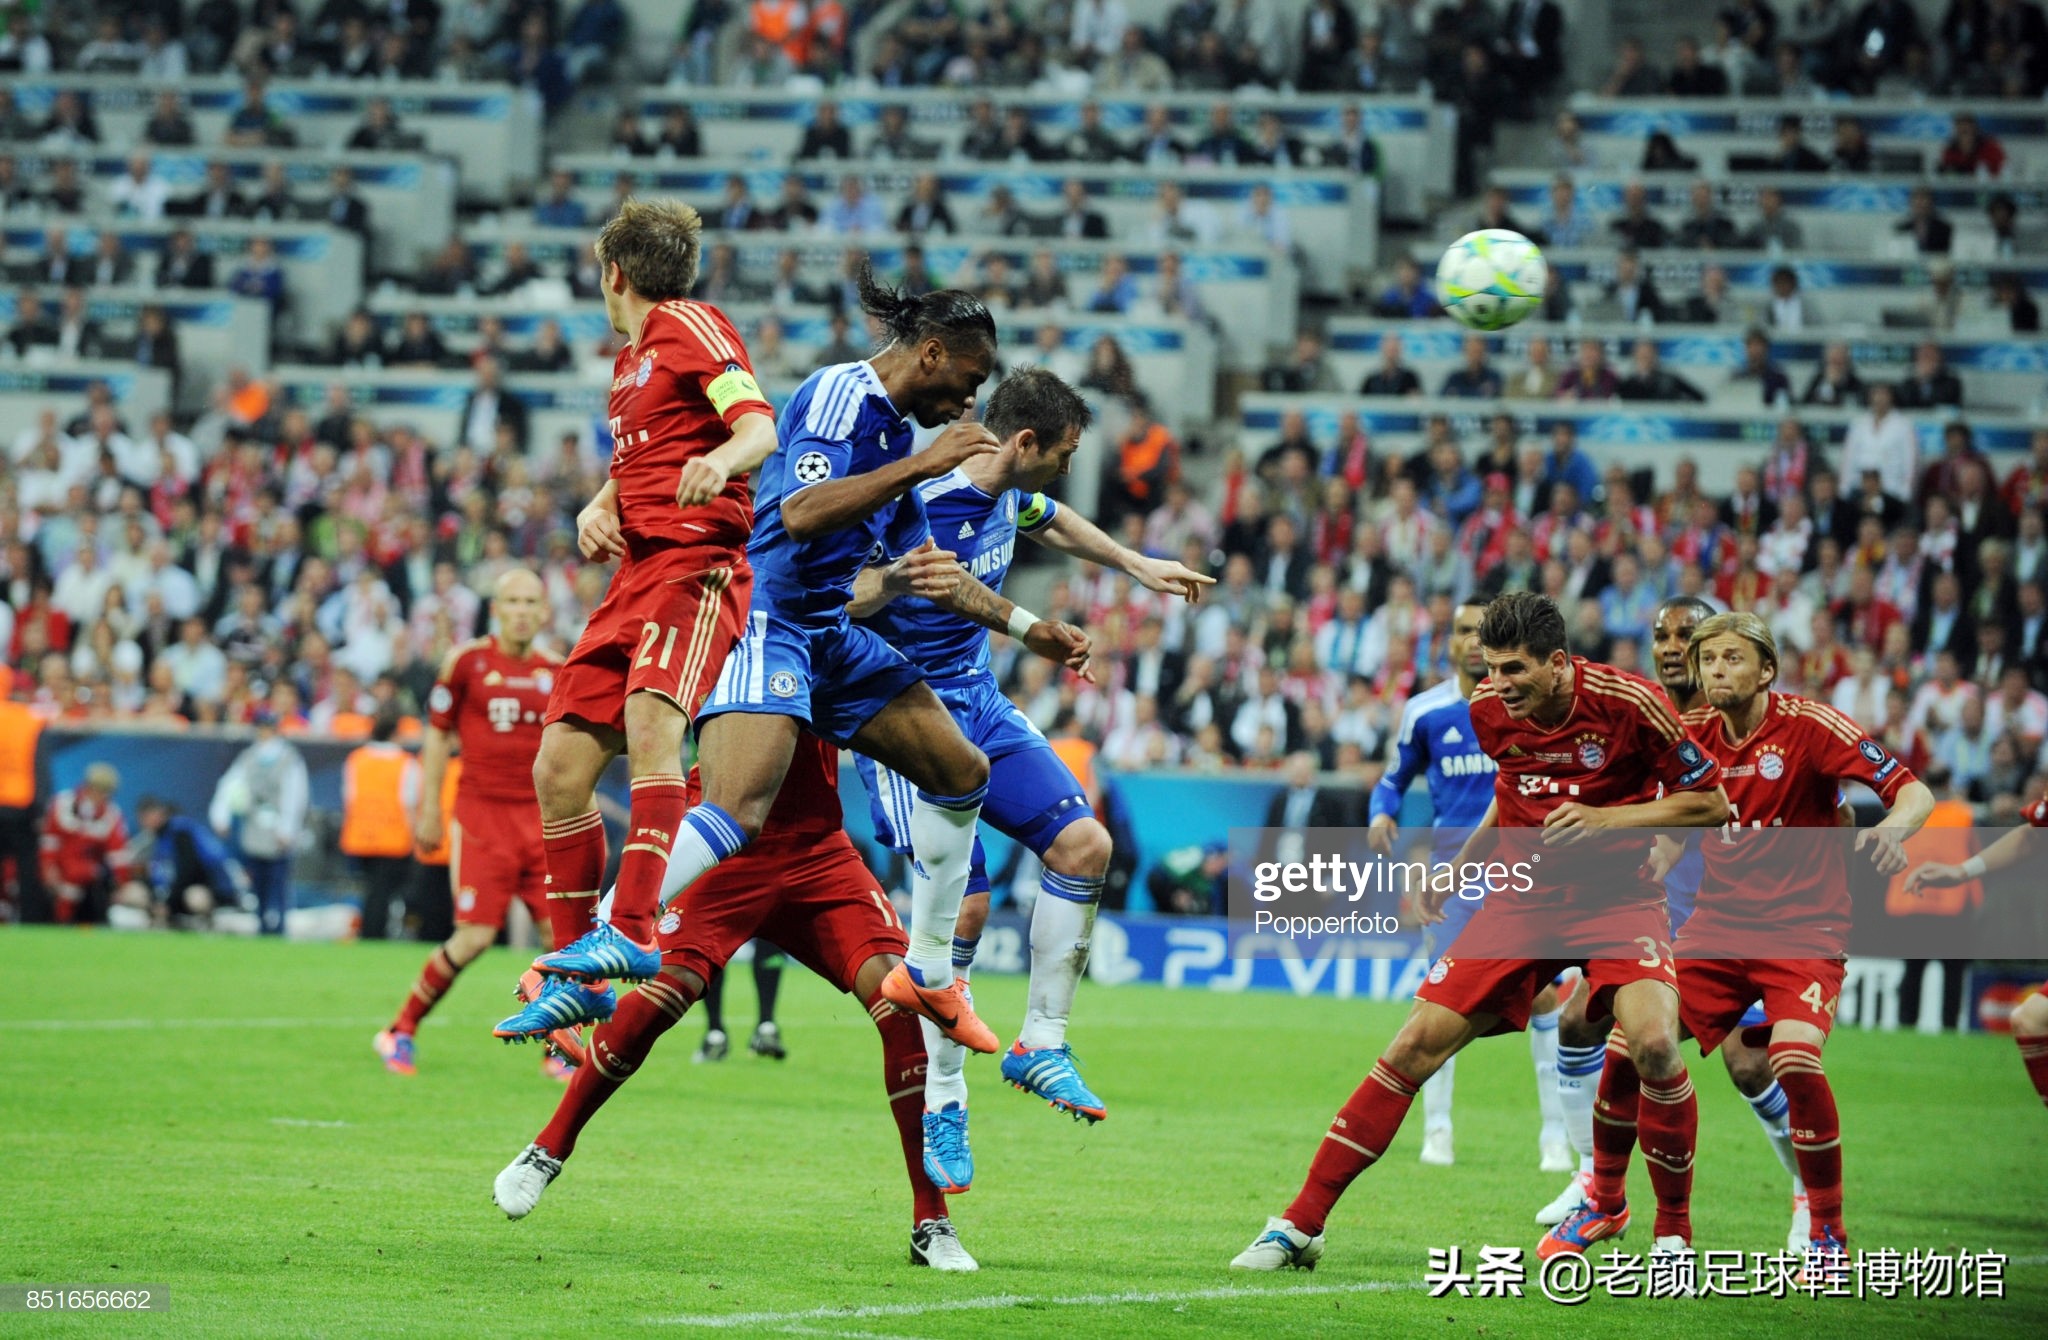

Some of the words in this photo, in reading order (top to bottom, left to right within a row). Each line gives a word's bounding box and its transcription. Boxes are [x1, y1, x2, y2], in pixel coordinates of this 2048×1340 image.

[635, 622, 679, 670] 21
[636, 828, 670, 844] FCB
[901, 1064, 927, 1081] FC
